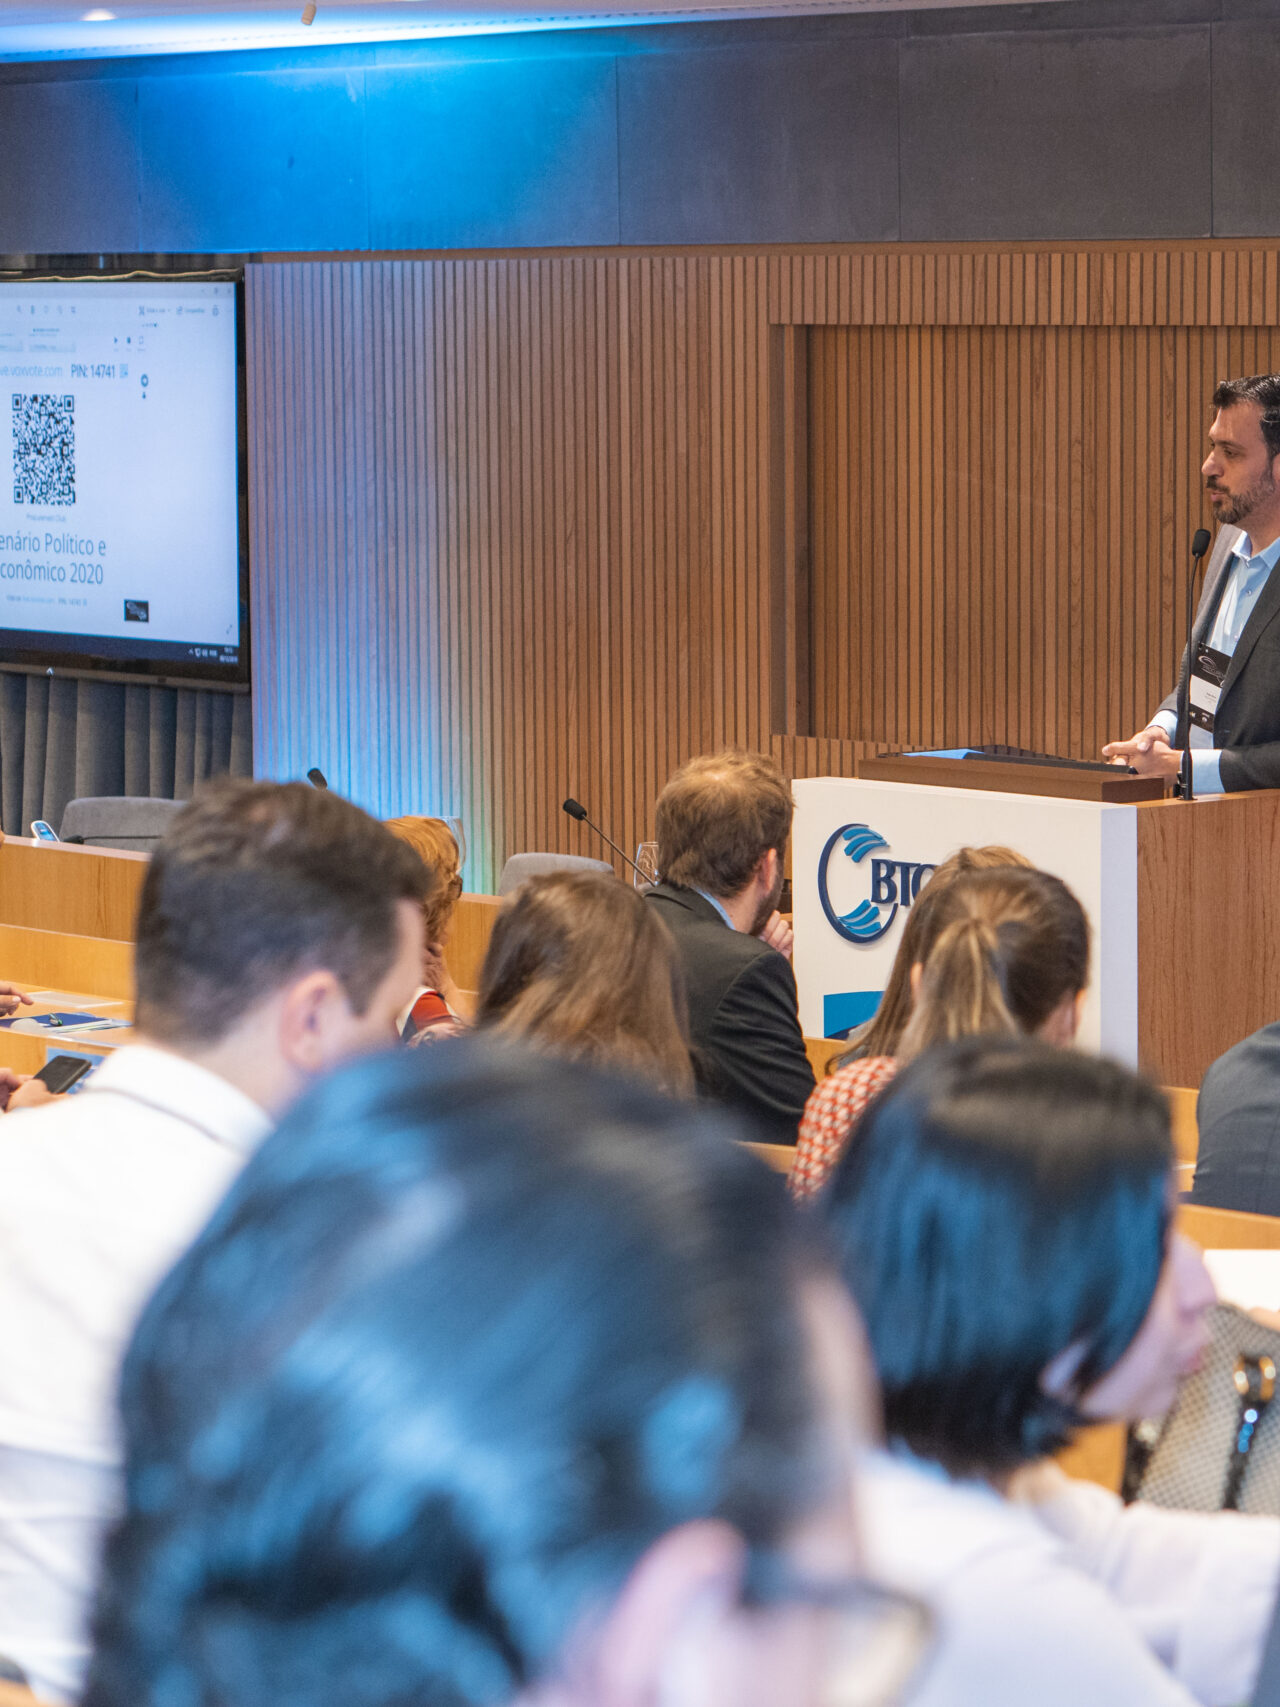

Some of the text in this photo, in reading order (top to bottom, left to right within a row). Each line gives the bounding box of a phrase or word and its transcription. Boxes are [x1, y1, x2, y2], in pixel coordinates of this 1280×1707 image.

[0, 363, 115, 379] ve.voxvote.com PIN: 14741
[0, 530, 106, 556] enário Político e
[0, 558, 104, 585] conômico 2020
